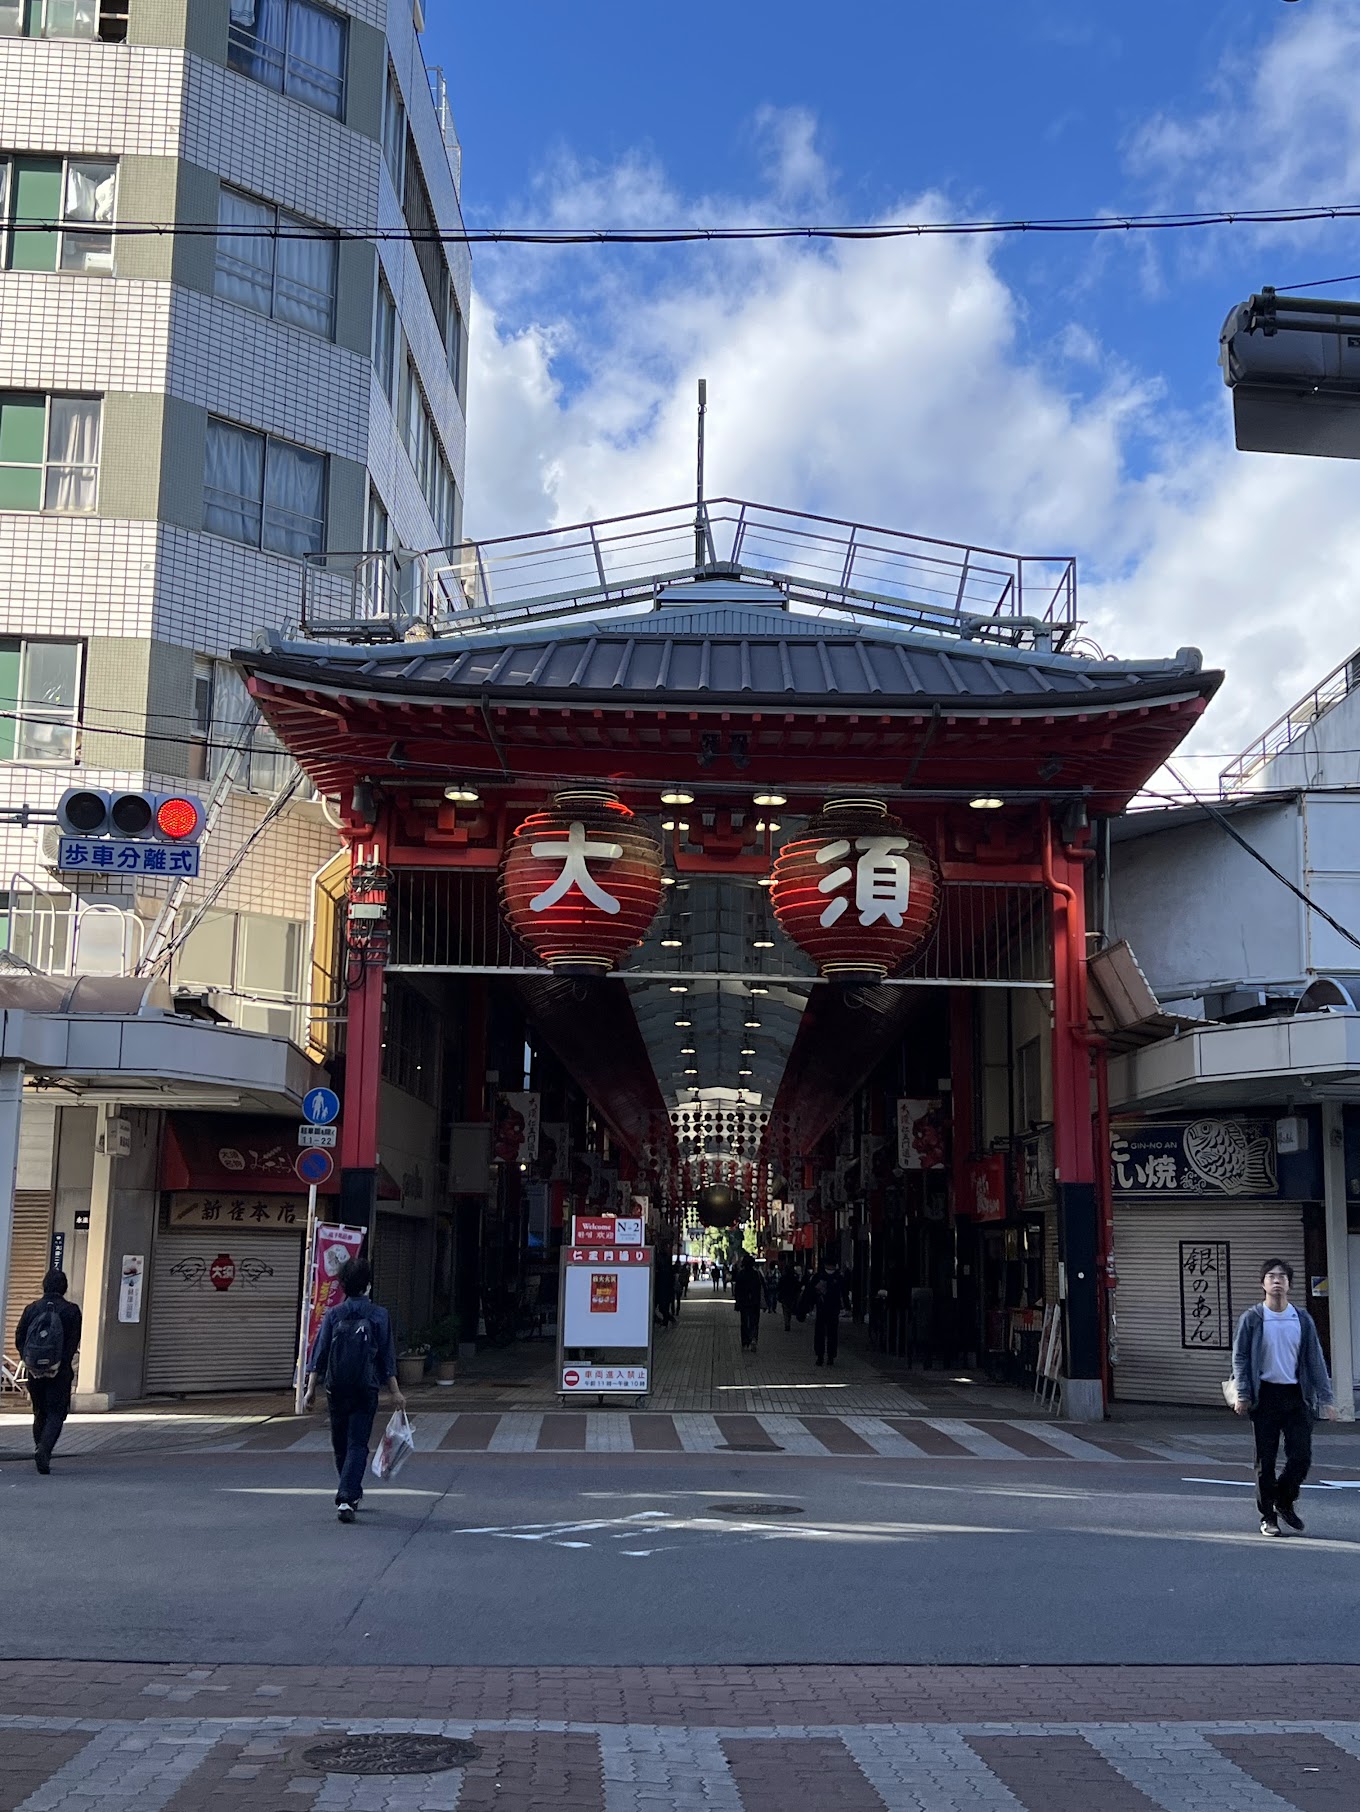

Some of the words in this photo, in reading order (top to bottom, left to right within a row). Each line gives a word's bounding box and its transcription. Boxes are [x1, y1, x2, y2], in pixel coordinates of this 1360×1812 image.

[65, 843, 192, 872] 歩車分離式
[530, 821, 623, 916] 大
[815, 836, 911, 928] 須
[303, 1136, 332, 1145] 11-22
[1130, 1141, 1163, 1150] GIN-NO
[1164, 1141, 1177, 1149] AN
[202, 1199, 296, 1224] 新雀本店
[582, 1222, 612, 1231] Welcome
[573, 1250, 644, 1261] 仁王門通り
[212, 1265, 235, 1279] 大須
[1184, 1248, 1217, 1342] 銀のあん
[584, 1370, 645, 1379] 車両進入禁止
